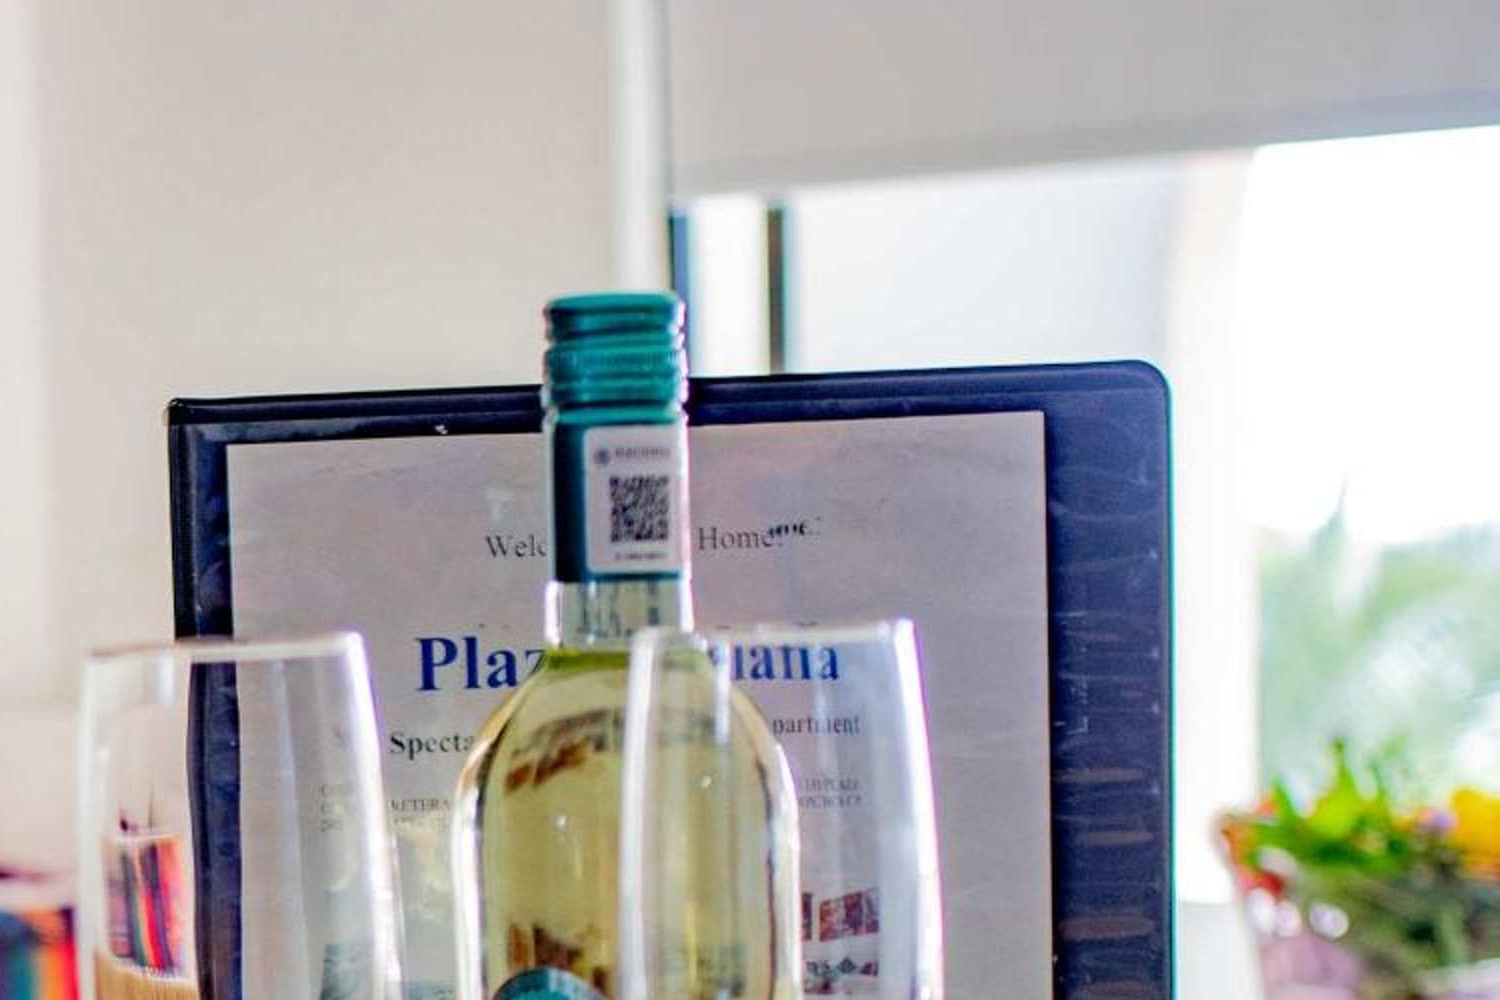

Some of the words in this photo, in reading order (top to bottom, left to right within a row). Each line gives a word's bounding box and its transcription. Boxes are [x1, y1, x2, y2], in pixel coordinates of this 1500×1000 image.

[485, 533, 548, 558] Welc
[417, 636, 547, 691] Plaz
[772, 715, 860, 737] partent
